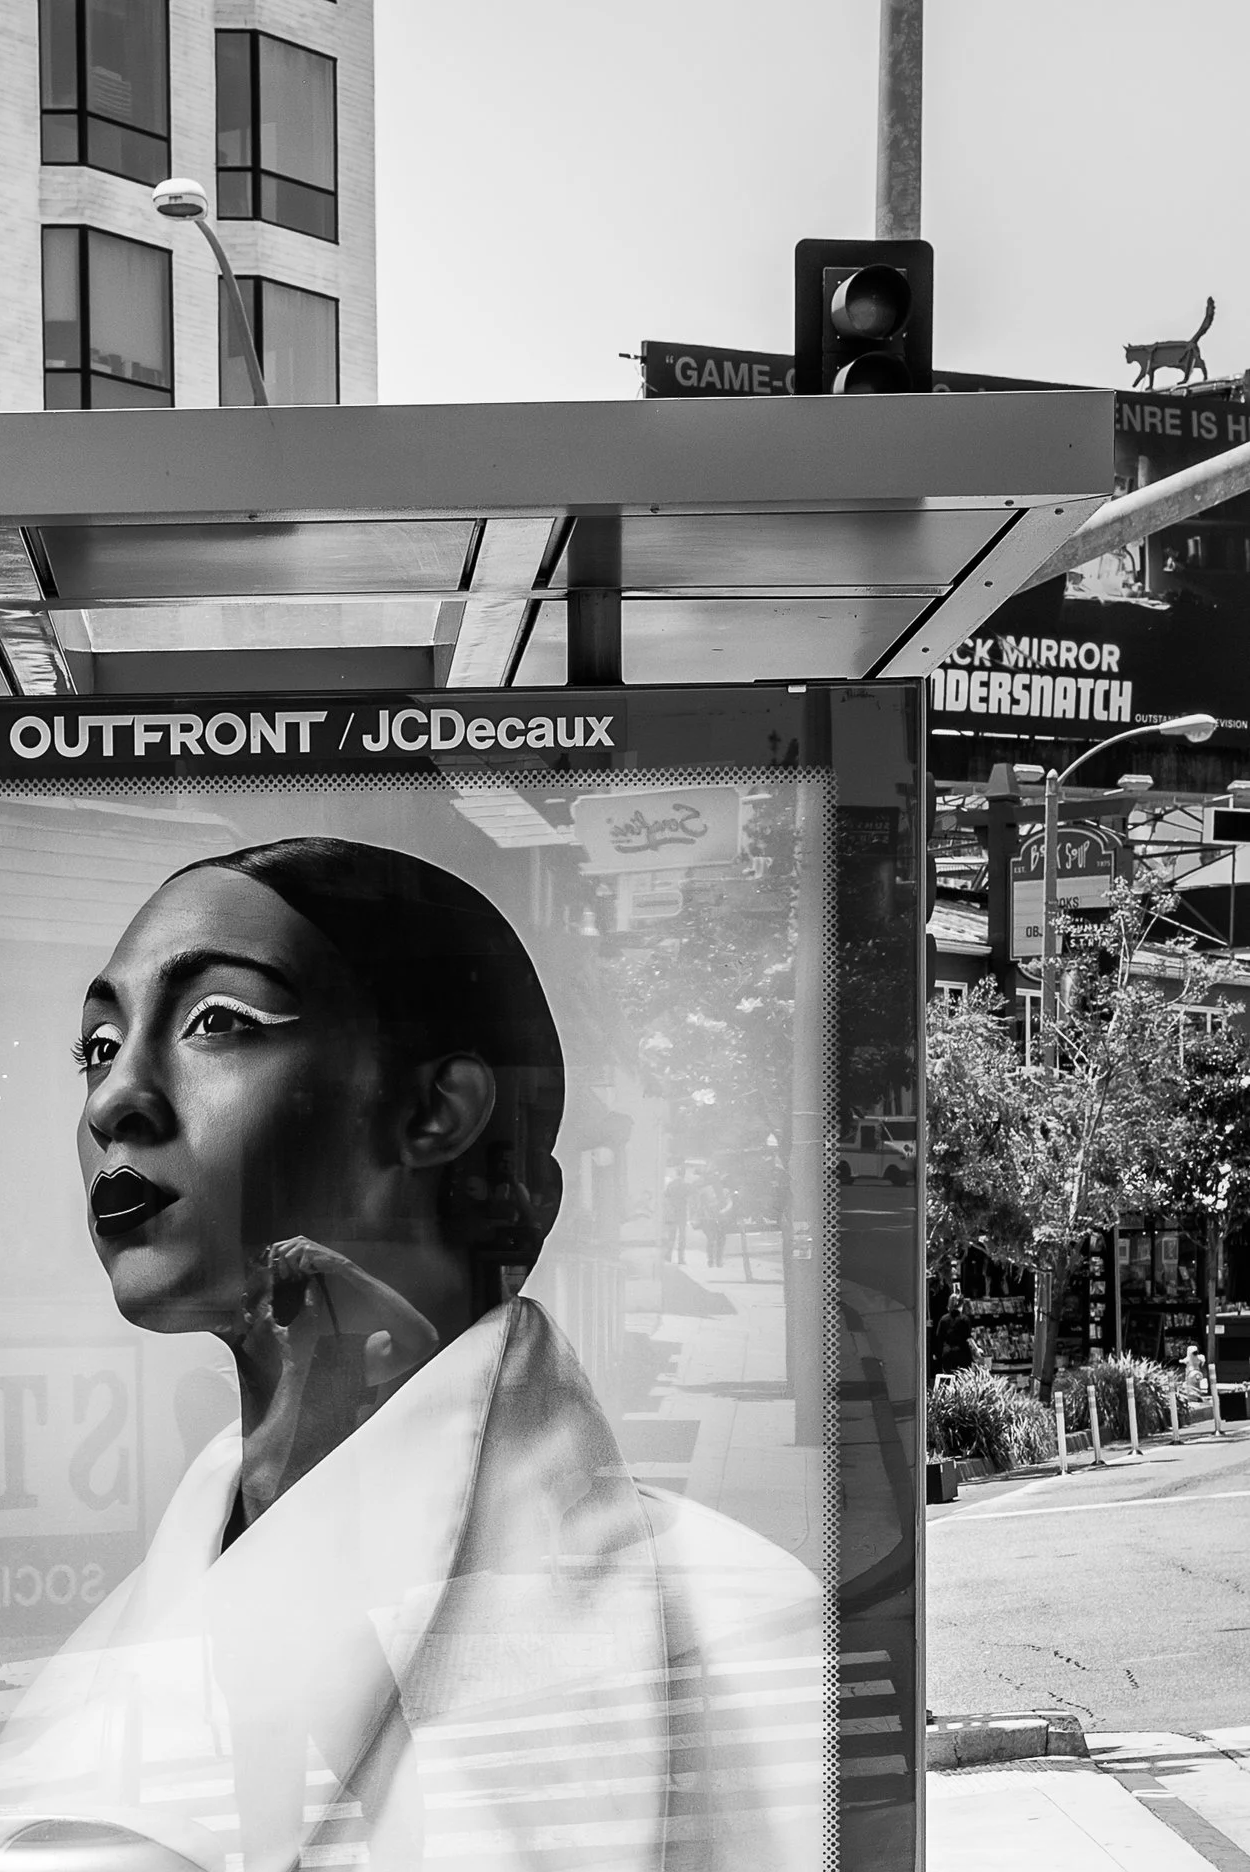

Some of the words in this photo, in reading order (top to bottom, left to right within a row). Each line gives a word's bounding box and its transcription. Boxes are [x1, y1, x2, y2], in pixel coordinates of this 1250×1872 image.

[1115, 402, 1182, 436] NRE
[1191, 410, 1218, 440] IS
[1227, 414, 1250, 442] H
[945, 638, 994, 667] CK
[1002, 636, 1120, 673] MIRROR
[9, 711, 328, 759] OUTFRONT
[362, 709, 615, 753] JCDecaux
[1031, 843, 1061, 872] BOK
[1056, 897, 1079, 908] OKS
[1025, 926, 1044, 938] OB
